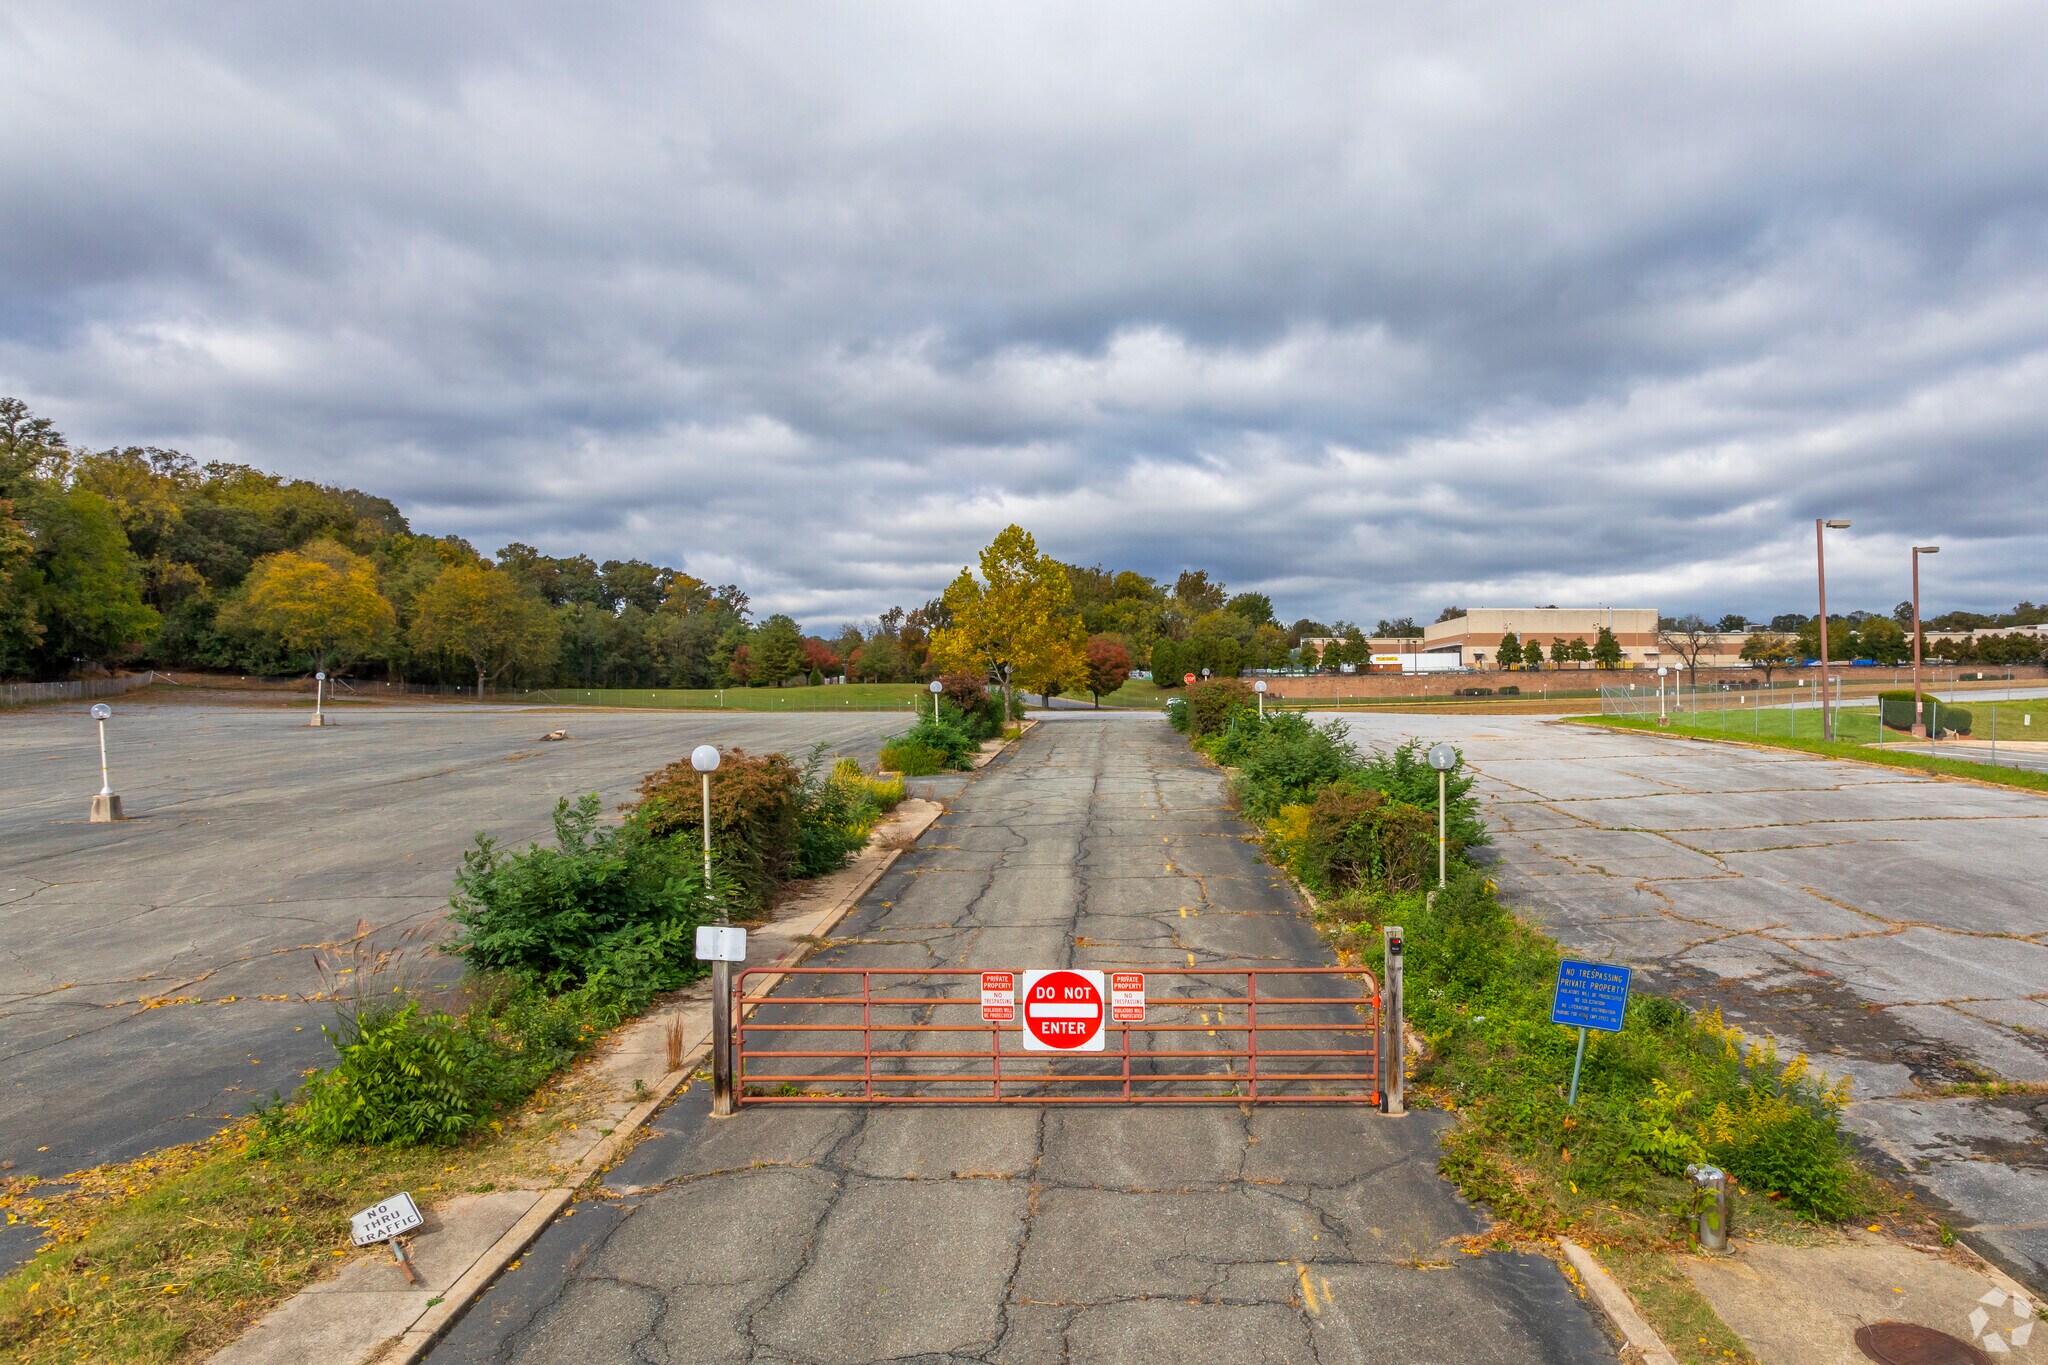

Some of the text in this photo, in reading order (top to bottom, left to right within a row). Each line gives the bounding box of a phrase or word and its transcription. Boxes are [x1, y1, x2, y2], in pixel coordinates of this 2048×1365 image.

[1566, 968, 1623, 983] NO TRESPASSING
[1036, 987, 1091, 999] DO NOT
[1560, 978, 1625, 994] PRIVATE PROPERTY
[1041, 1022, 1086, 1034] ENTER
[367, 1205, 387, 1219] NO
[359, 1215, 416, 1242] TRAFFIC
[363, 1211, 400, 1231] THRU
